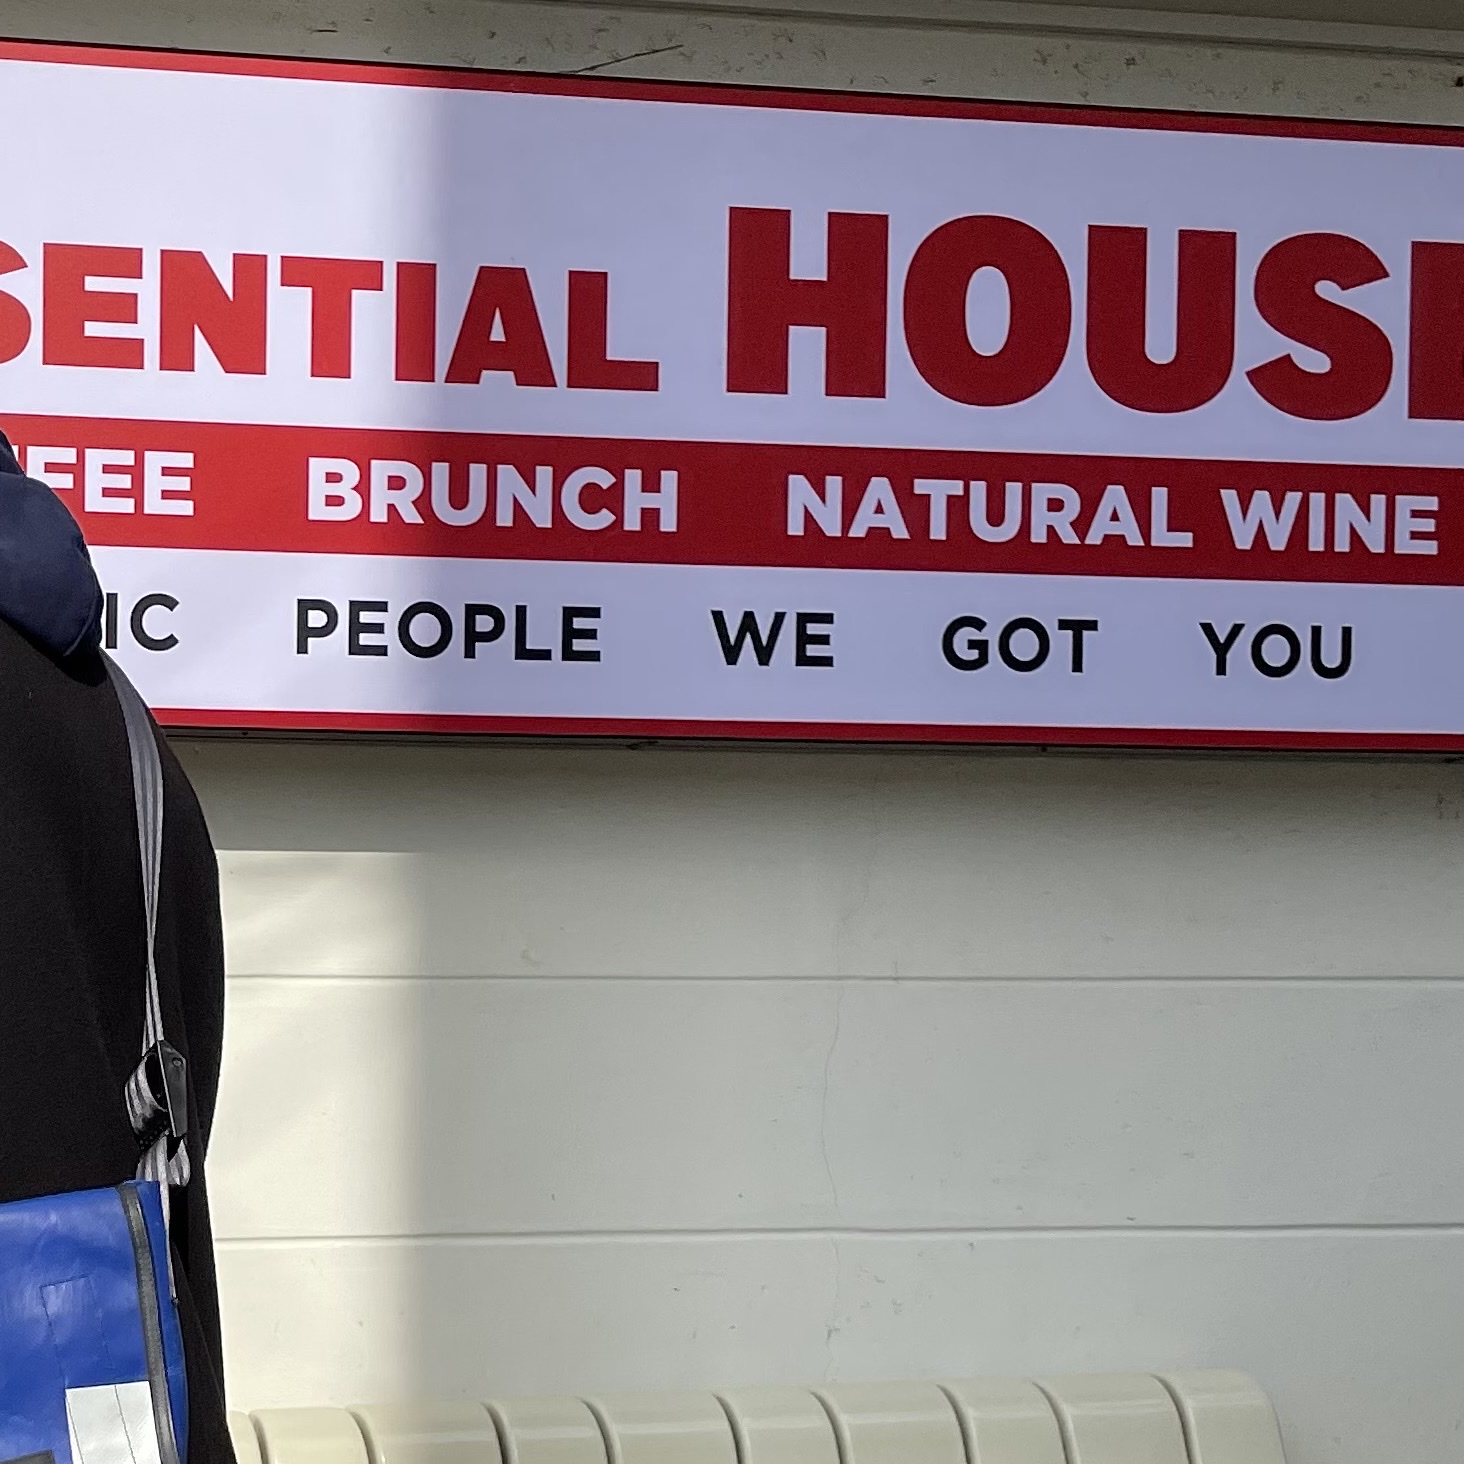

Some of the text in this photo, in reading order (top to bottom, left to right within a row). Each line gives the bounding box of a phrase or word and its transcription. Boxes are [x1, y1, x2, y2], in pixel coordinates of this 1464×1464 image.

[10, 444, 1440, 555] FEE BRUNCH NATURAL WINE
[296, 598, 602, 662] PEOPLE
[710, 610, 834, 667] WE
[941, 615, 1099, 674] GOT
[1199, 622, 1353, 679] YOU
